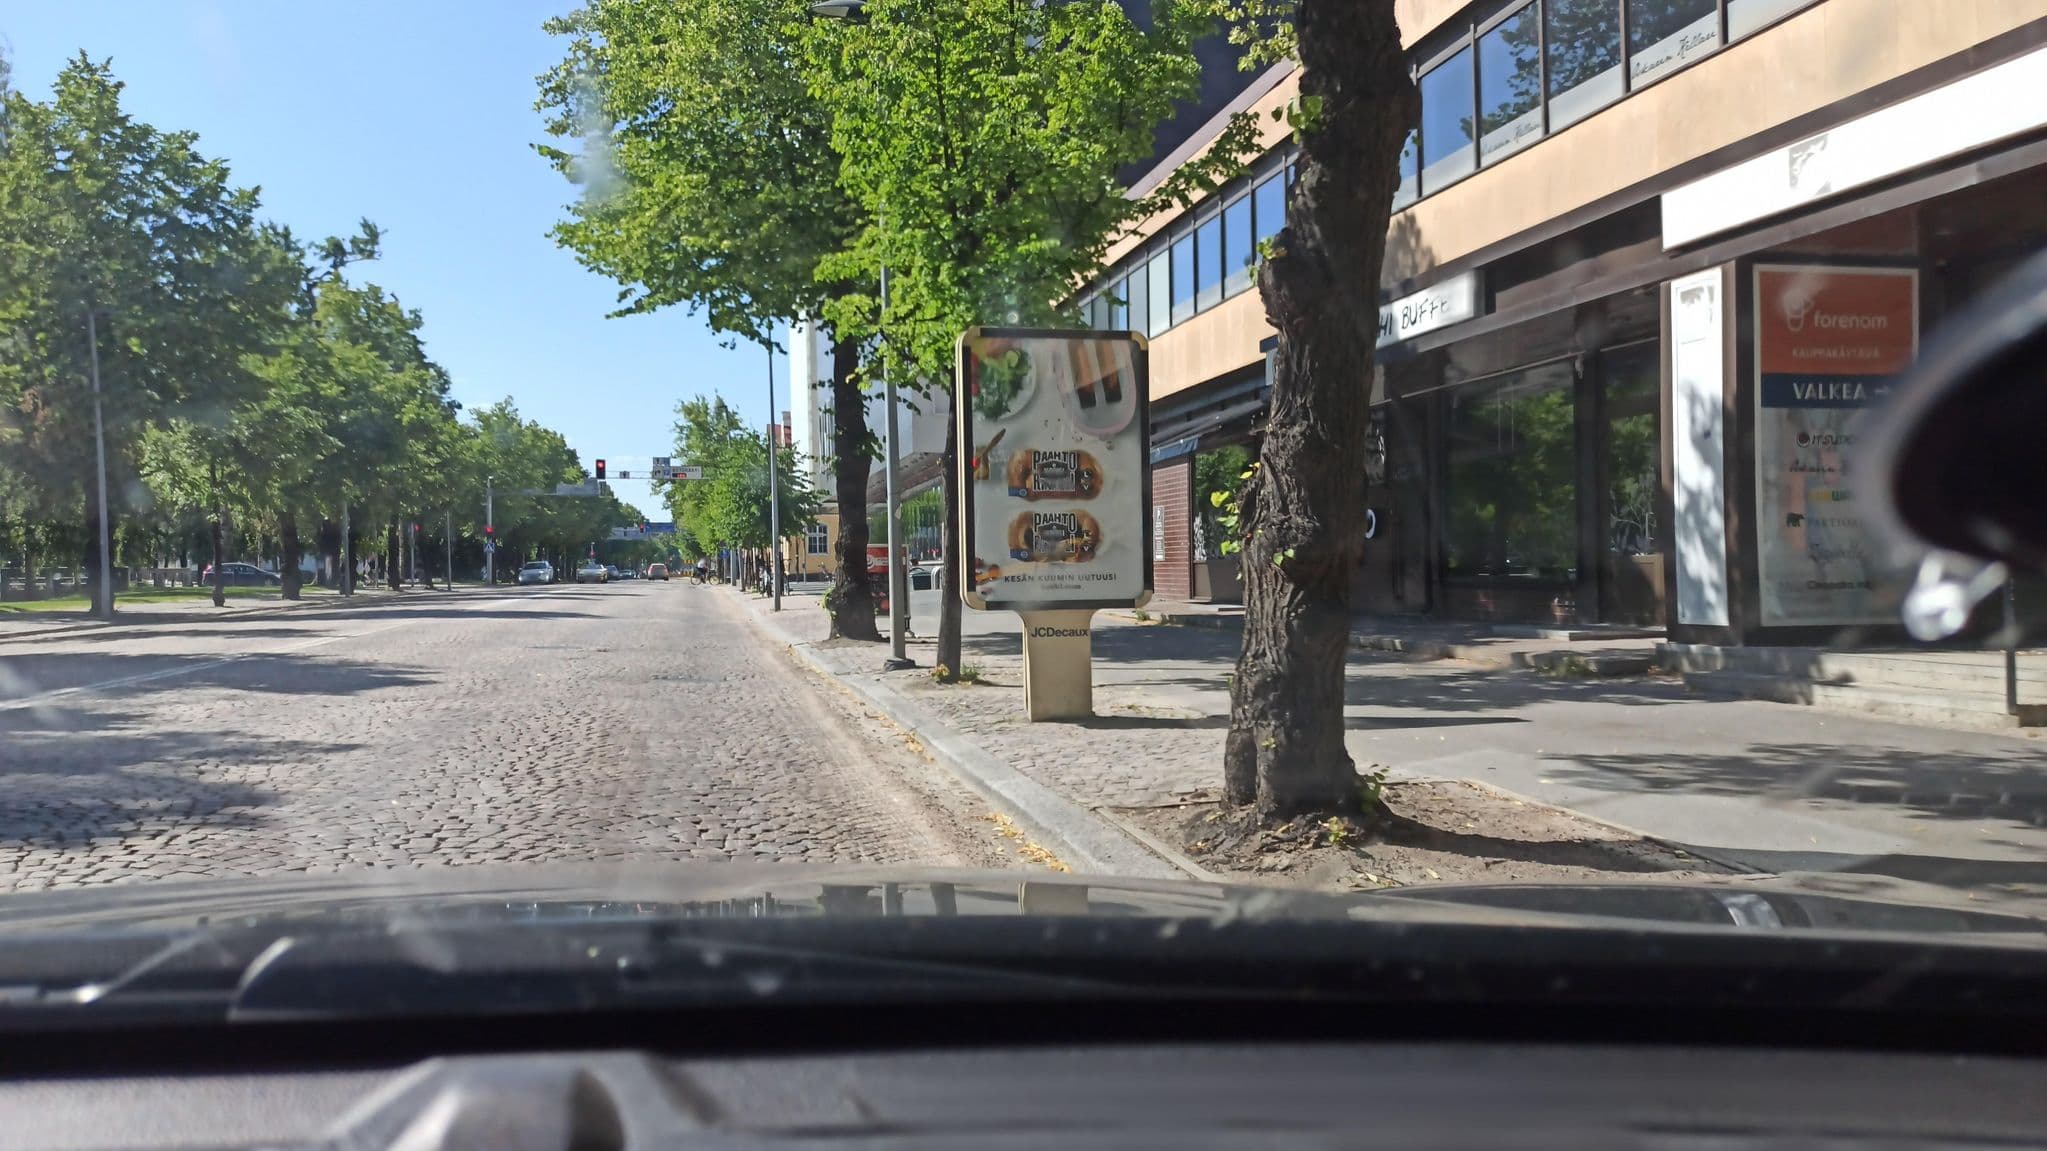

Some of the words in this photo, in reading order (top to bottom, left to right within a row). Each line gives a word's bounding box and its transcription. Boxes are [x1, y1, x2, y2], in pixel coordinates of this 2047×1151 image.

[1814, 310, 1888, 329] forenom
[1793, 383, 1866, 400] VALKEA
[1032, 450, 1077, 472] PAAHTO
[1033, 512, 1077, 534] PAAHTO
[1004, 573, 1034, 583] KESÄN
[1031, 627, 1089, 637] JCDecaux
